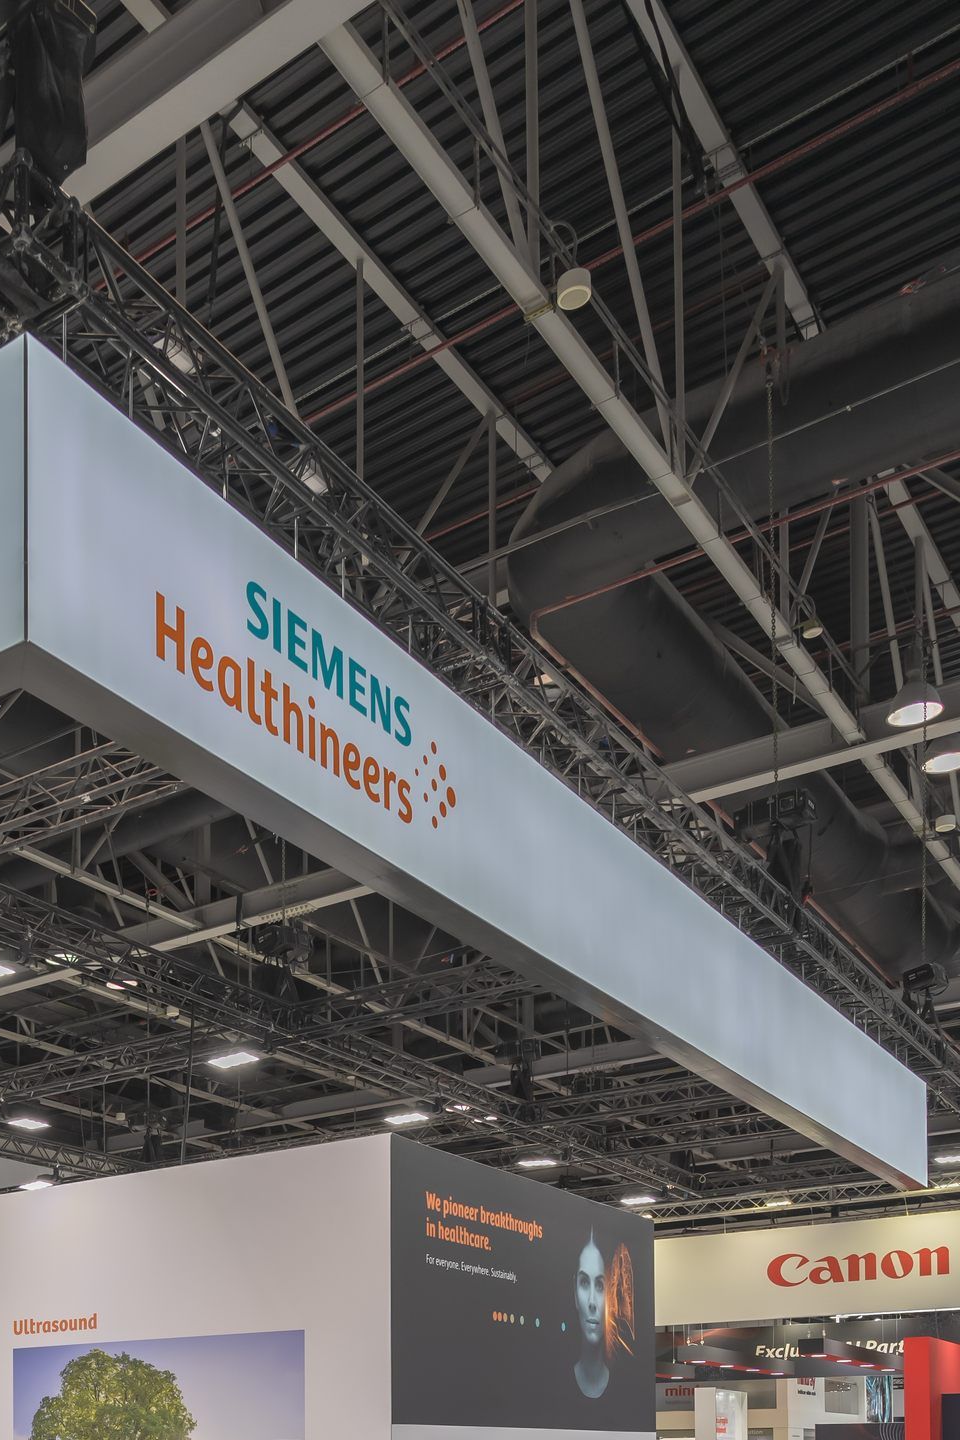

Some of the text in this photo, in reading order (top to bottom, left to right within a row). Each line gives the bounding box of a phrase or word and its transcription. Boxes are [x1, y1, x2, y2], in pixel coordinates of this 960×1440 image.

[246, 581, 412, 747] SIEMENS
[155, 591, 413, 824] Healthineers
[425, 1191, 543, 1242] We pioneer breakthroughs
[426, 1217, 492, 1251] in healthcare.
[425, 1254, 518, 1283] For everyone. Everywhere. Sustainably.
[767, 1246, 950, 1287] Canon
[13, 1312, 98, 1336] Ultrasound
[755, 1344, 805, 1360] Exclu
